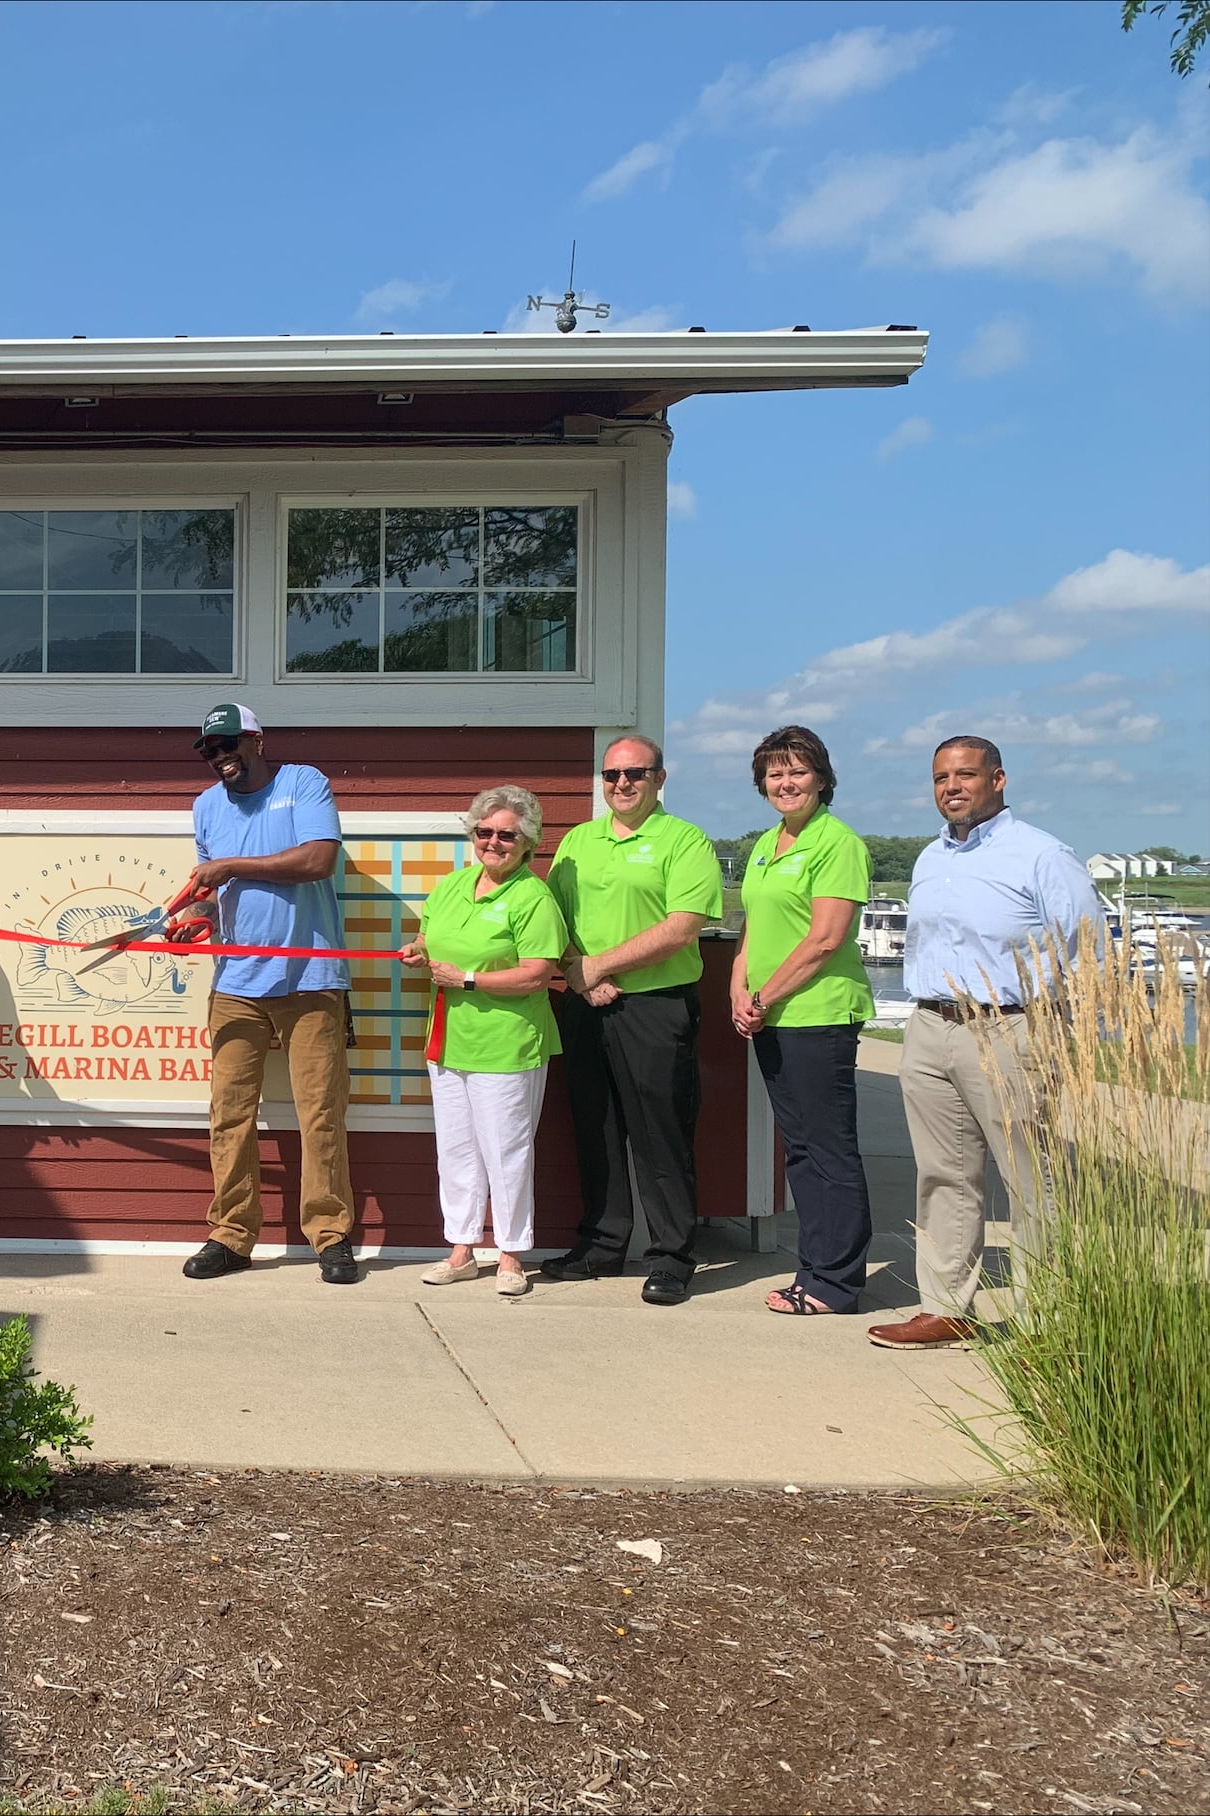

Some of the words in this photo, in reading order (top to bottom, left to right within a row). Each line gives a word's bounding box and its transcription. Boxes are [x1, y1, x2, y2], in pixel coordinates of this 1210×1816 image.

[526, 294, 543, 312] N
[595, 302, 611, 319] S
[41, 854, 101, 877] DRIVE
[24, 1056, 151, 1081] MARINA
